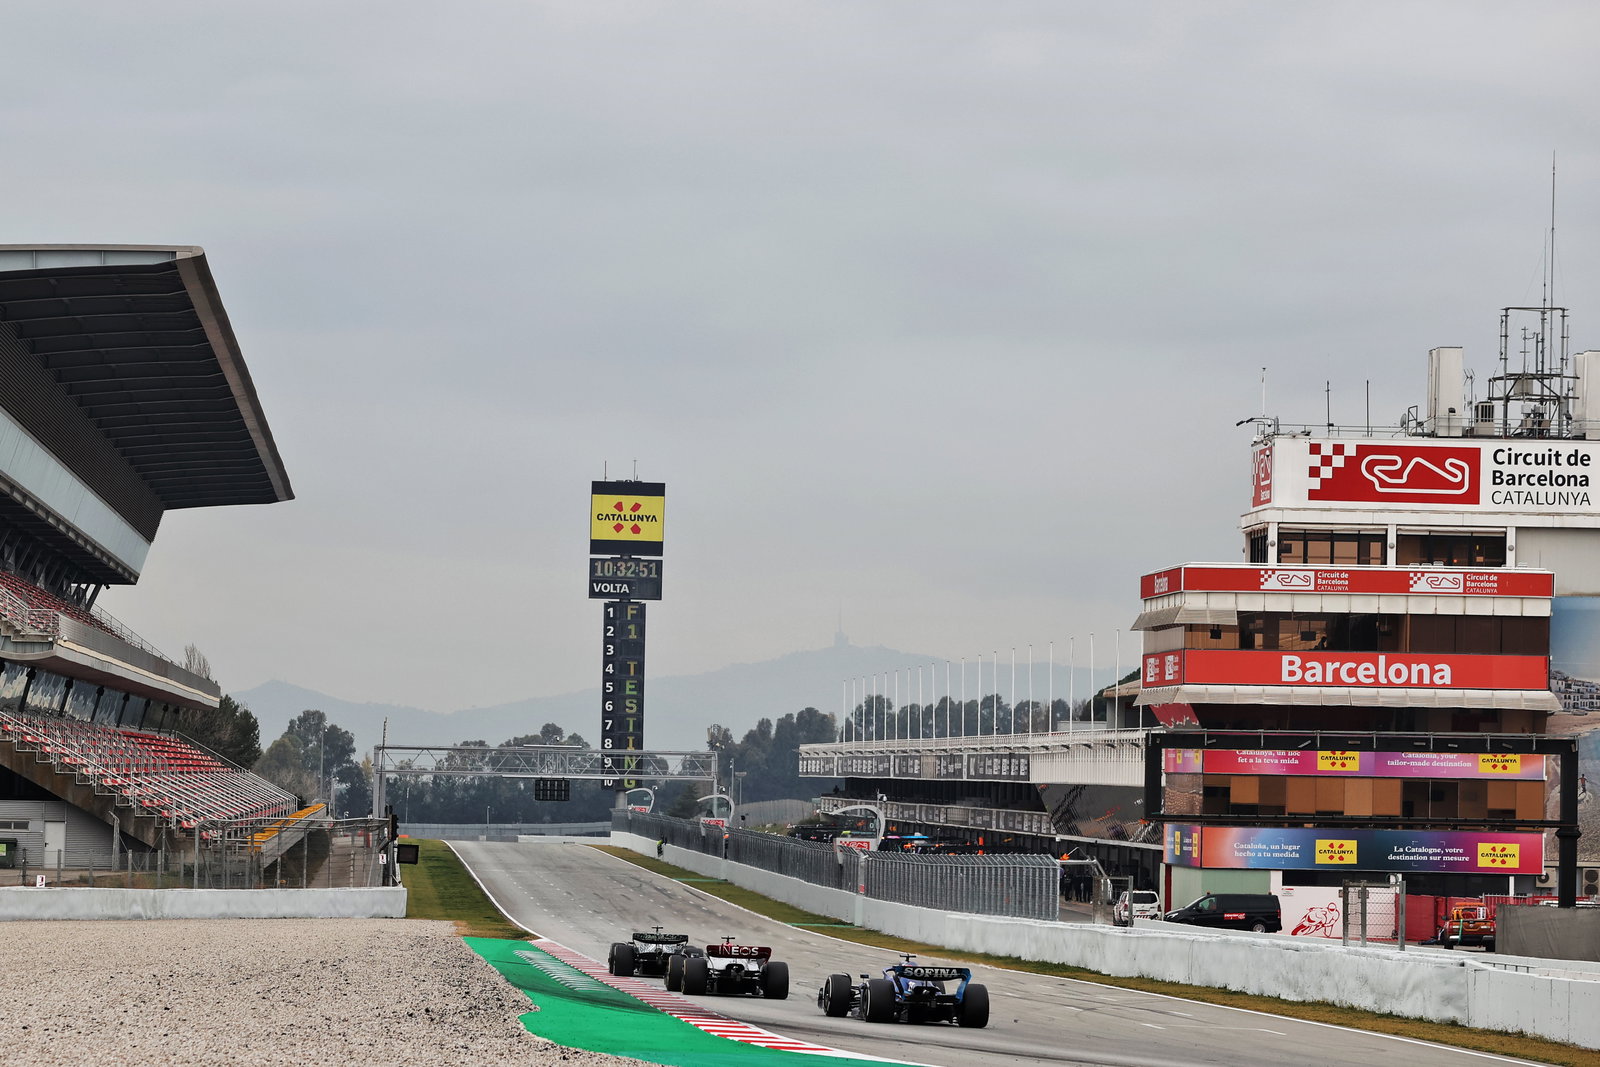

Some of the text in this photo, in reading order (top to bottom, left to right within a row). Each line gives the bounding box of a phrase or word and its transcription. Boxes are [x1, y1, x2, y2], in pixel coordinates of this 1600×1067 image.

[1492, 448, 1591, 466] Circuit de
[1492, 470, 1590, 487] Barcelona
[1492, 490, 1591, 506] CATALUNYA
[596, 514, 658, 522] CATALUNYA
[594, 560, 657, 578] 10:32:51
[593, 583, 630, 593] VOLTA
[607, 608, 614, 618] 1
[606, 626, 614, 636] 2
[606, 645, 614, 655] 3
[605, 664, 614, 674] 4
[1281, 655, 1452, 685] Barcelona
[605, 682, 614, 692] 5
[605, 701, 613, 711] 6
[605, 720, 613, 730] 7
[604, 738, 612, 749] 8
[604, 757, 612, 768] 9
[719, 946, 759, 956] INEOS
[904, 968, 958, 977] SOFINA
